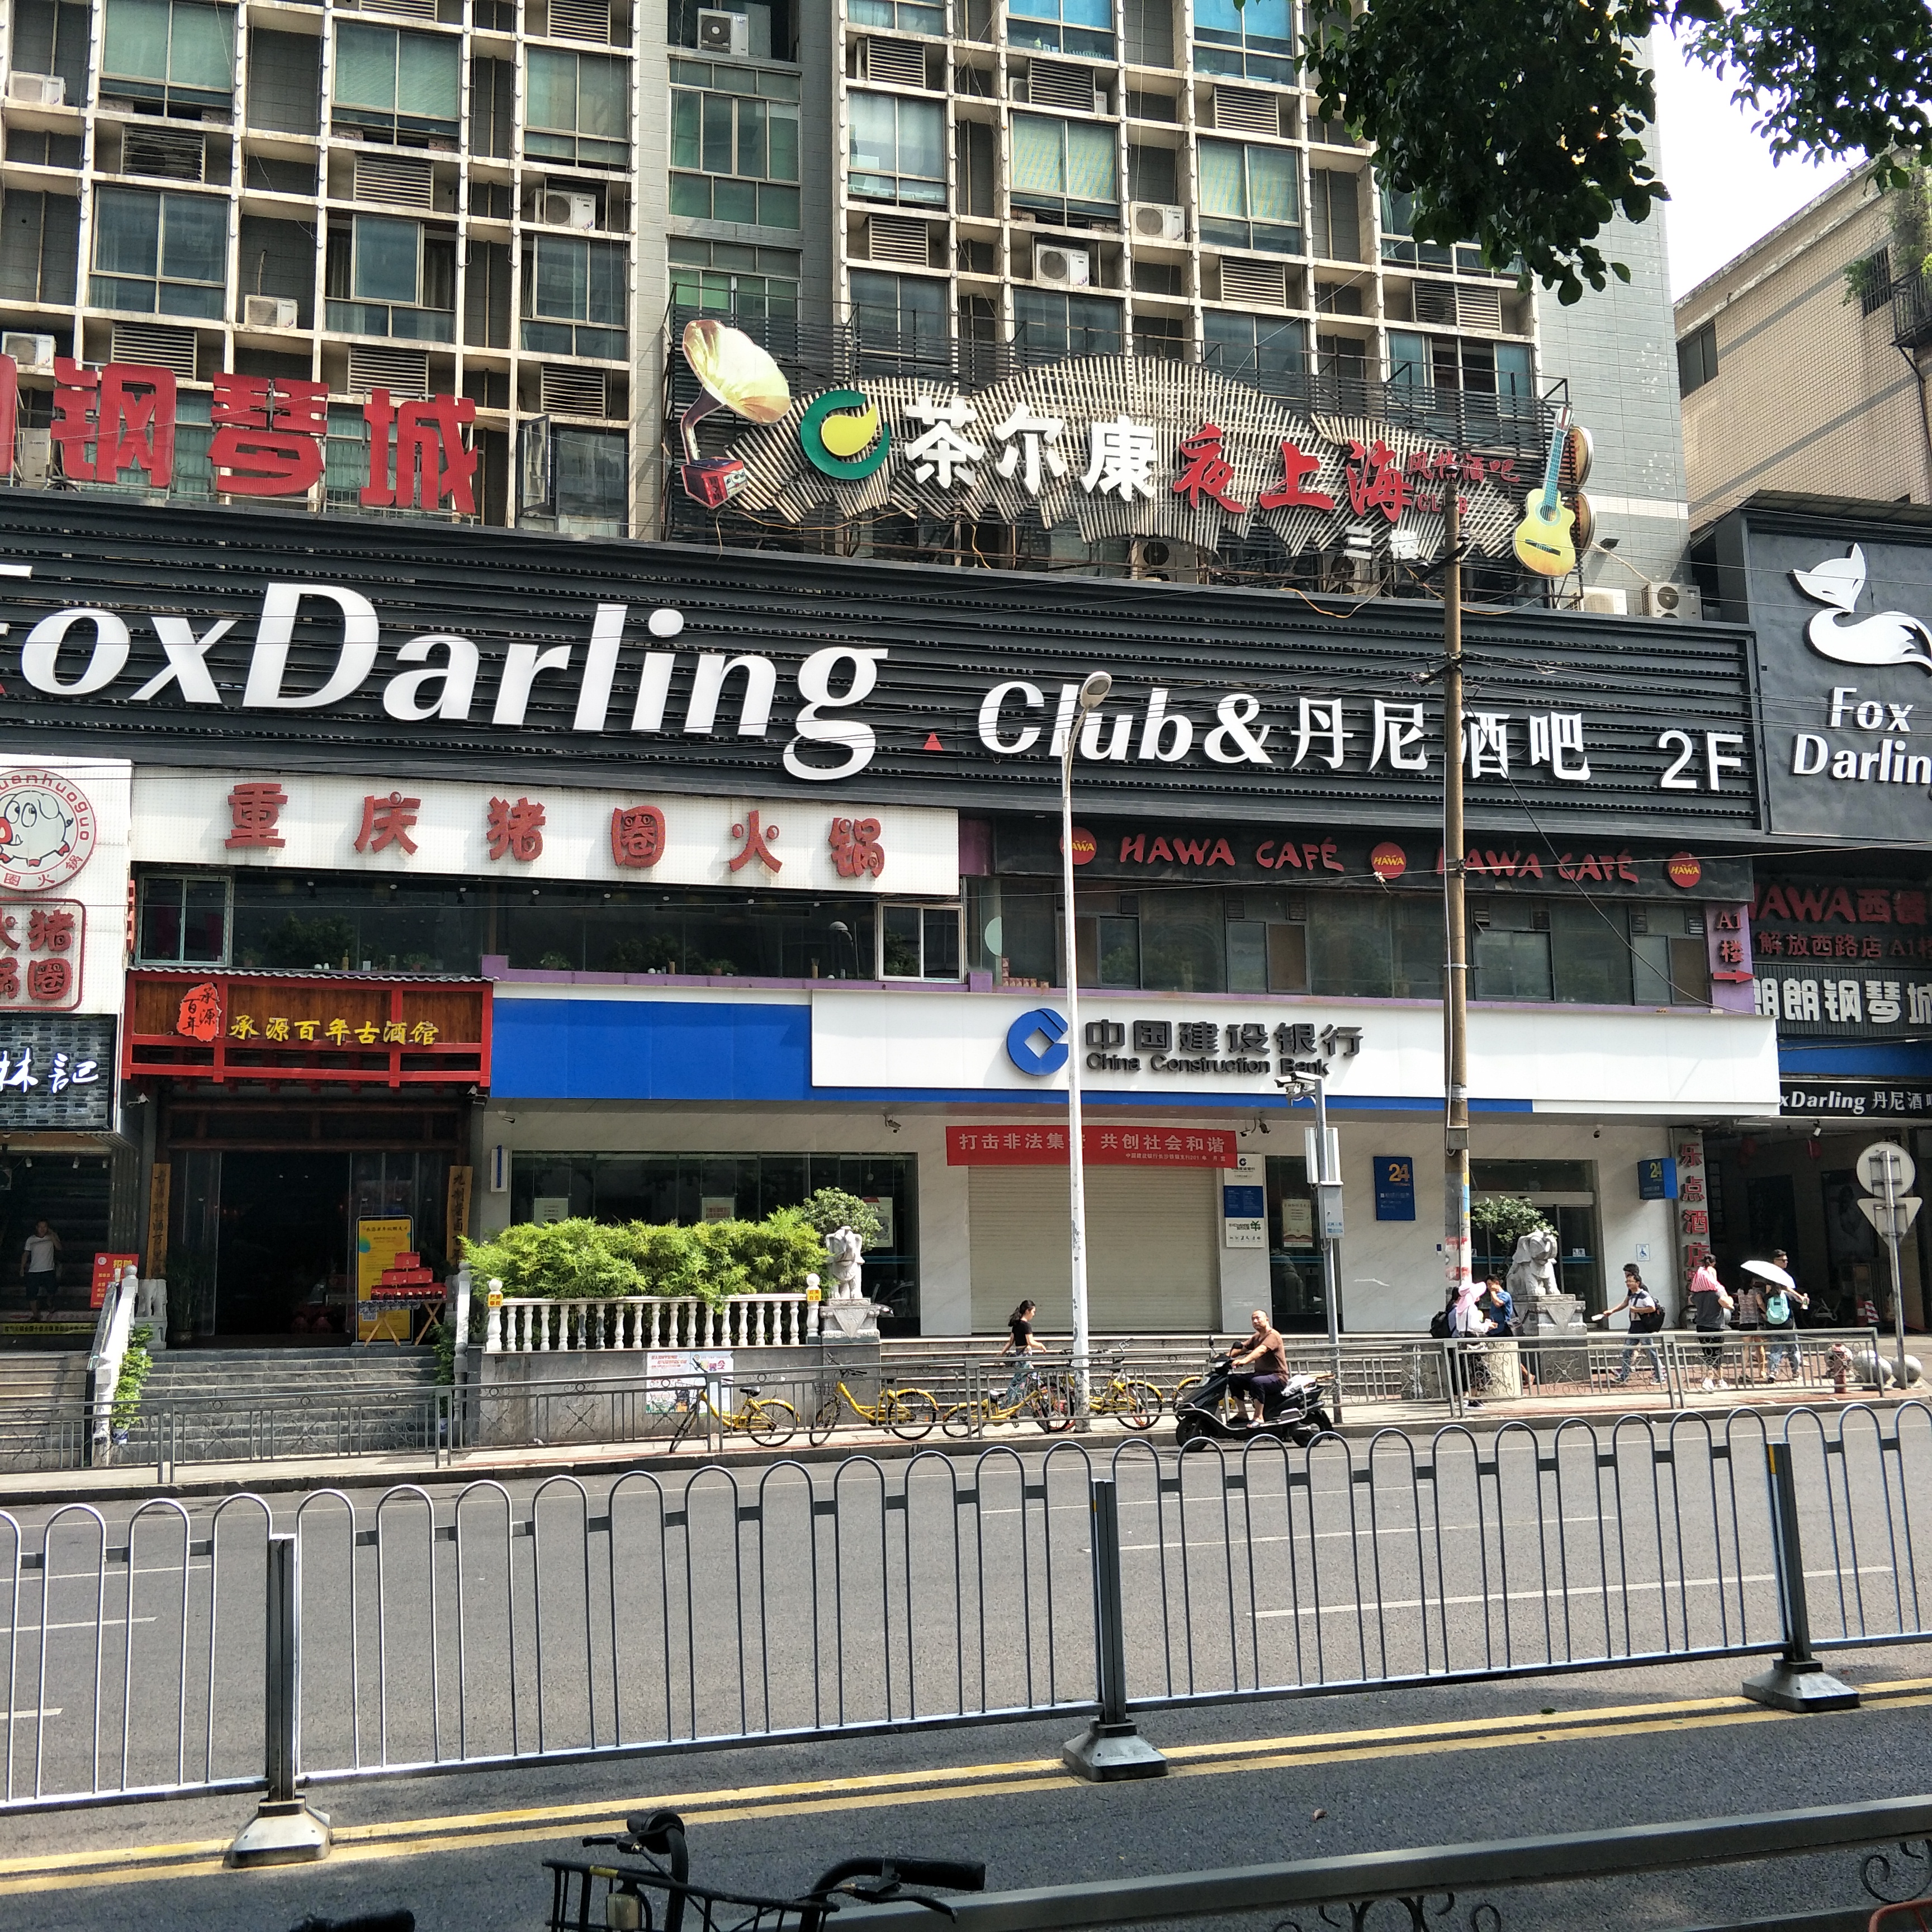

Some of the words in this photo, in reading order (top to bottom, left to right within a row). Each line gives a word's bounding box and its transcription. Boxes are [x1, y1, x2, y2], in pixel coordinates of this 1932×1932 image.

[0, 353, 477, 514] 钢琴城
[905, 395, 1158, 502] 茶尔康
[1174, 423, 1415, 523] 夜上海
[1417, 493, 1468, 514] CLB
[1343, 526, 1420, 561] 三楼
[1830, 686, 1915, 732] Fox
[1657, 729, 1744, 791] 2F
[224, 783, 885, 878] 重庆猪圈火锅
[1063, 840, 1095, 853] AWA
[1119, 834, 1235, 866] HAWA
[1256, 837, 1344, 872] CAFÉ
[1374, 854, 1405, 867] HAWA
[1671, 864, 1701, 877] HAWA
[1716, 911, 1742, 930] A1
[1720, 939, 1744, 963] 楼
[1759, 930, 1882, 958] 解放西路店
[1086, 1019, 1364, 1057] 中国建设银行
[1086, 1052, 1142, 1072] China
[1150, 1056, 1271, 1074] Construction
[1279, 1058, 1330, 1077] Bank
[1101, 1133, 1225, 1153] 共创社会和谐
[1389, 1163, 1410, 1182] 24
[1650, 1162, 1663, 1178] 24
